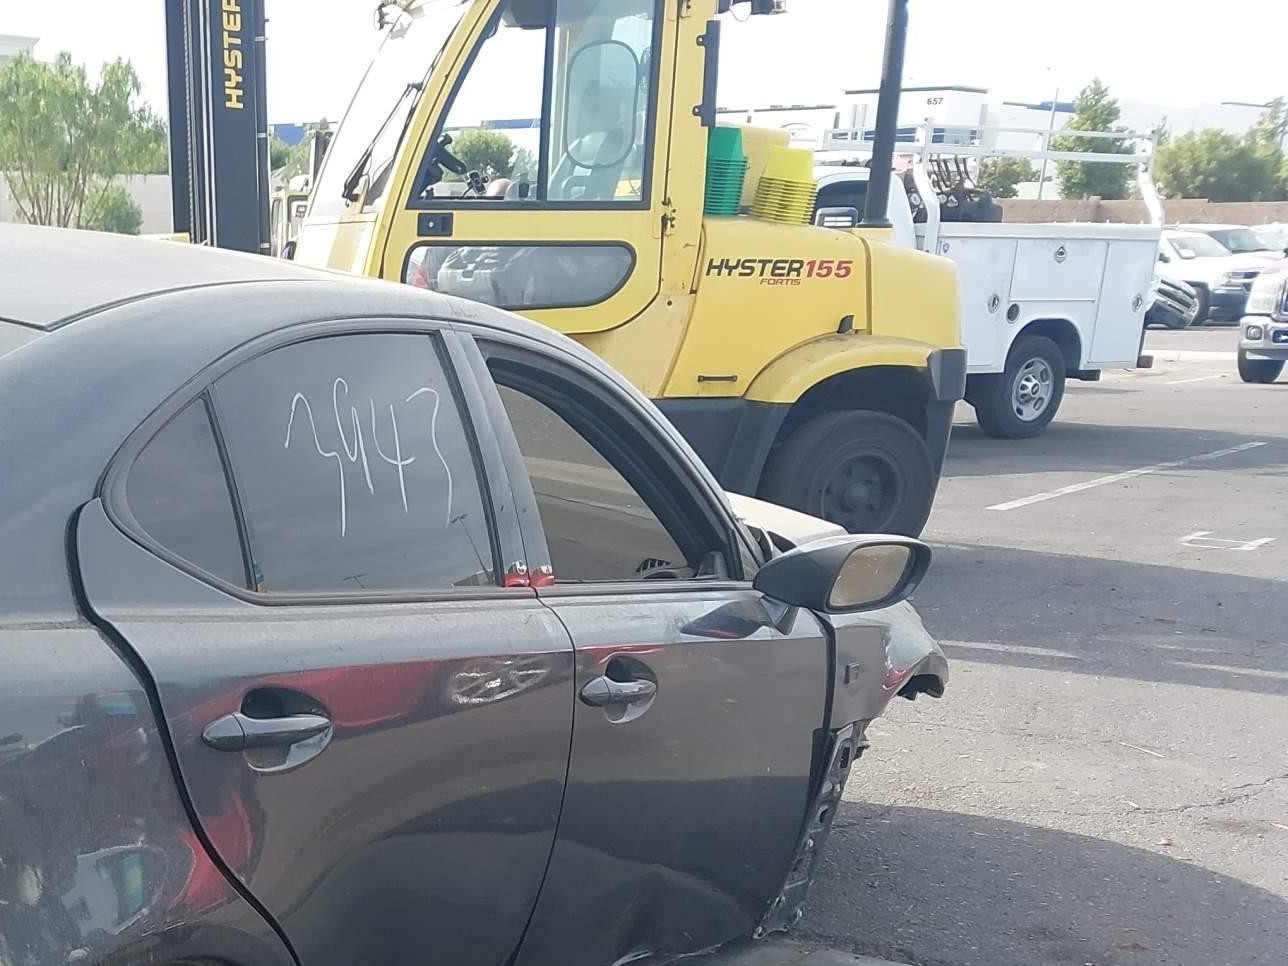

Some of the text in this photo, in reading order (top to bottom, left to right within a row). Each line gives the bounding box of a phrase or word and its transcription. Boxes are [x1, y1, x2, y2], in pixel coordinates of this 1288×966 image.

[926, 97, 944, 106] 657
[705, 258, 854, 279] HYSTER 155
[760, 278, 802, 287] FORTIS
